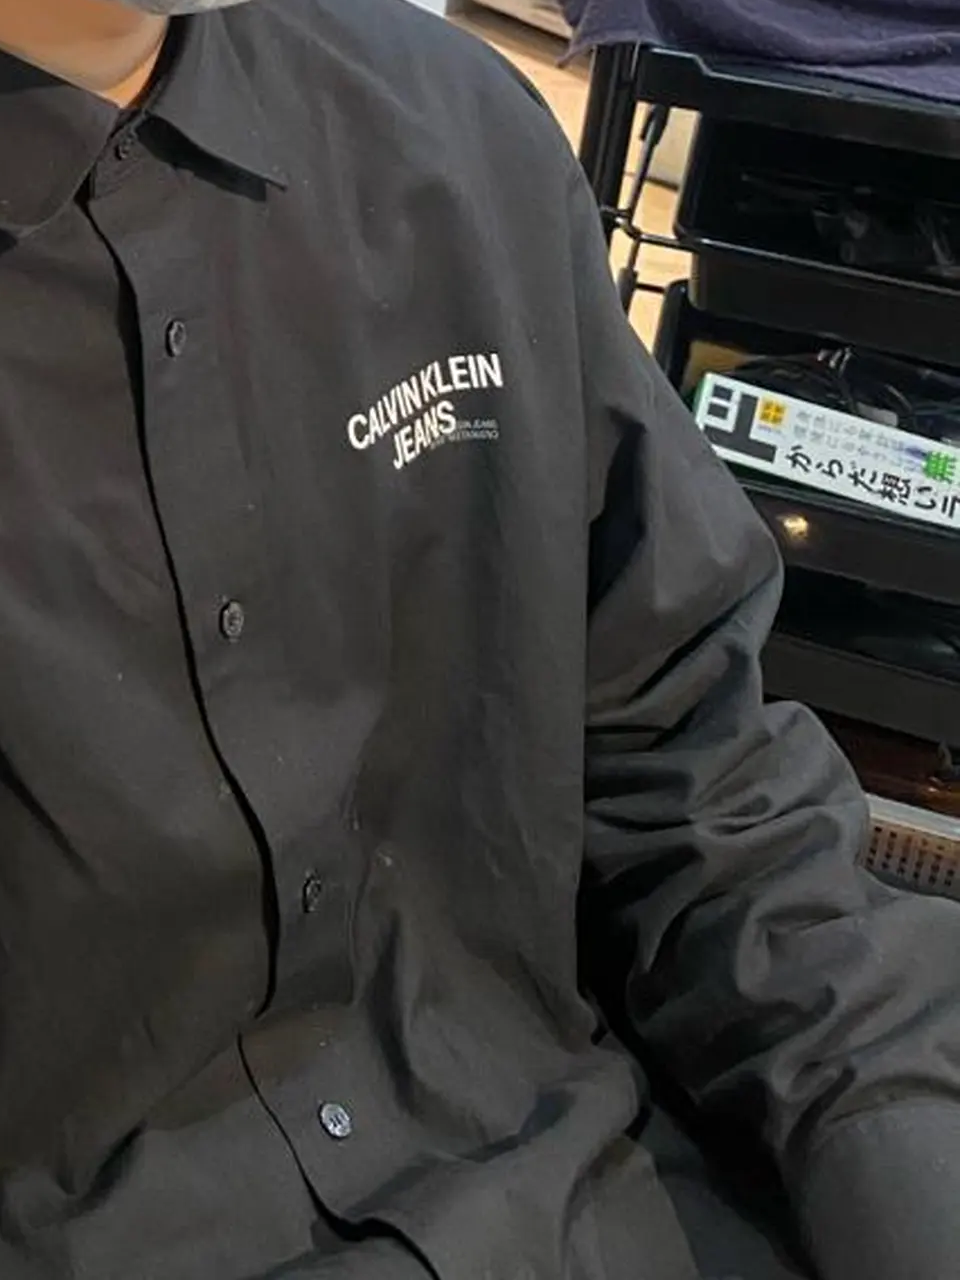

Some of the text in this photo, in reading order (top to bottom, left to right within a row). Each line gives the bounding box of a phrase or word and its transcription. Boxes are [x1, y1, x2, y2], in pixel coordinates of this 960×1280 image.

[347, 353, 504, 450] CALVIN KLEIN
[393, 400, 456, 469] JEANS
